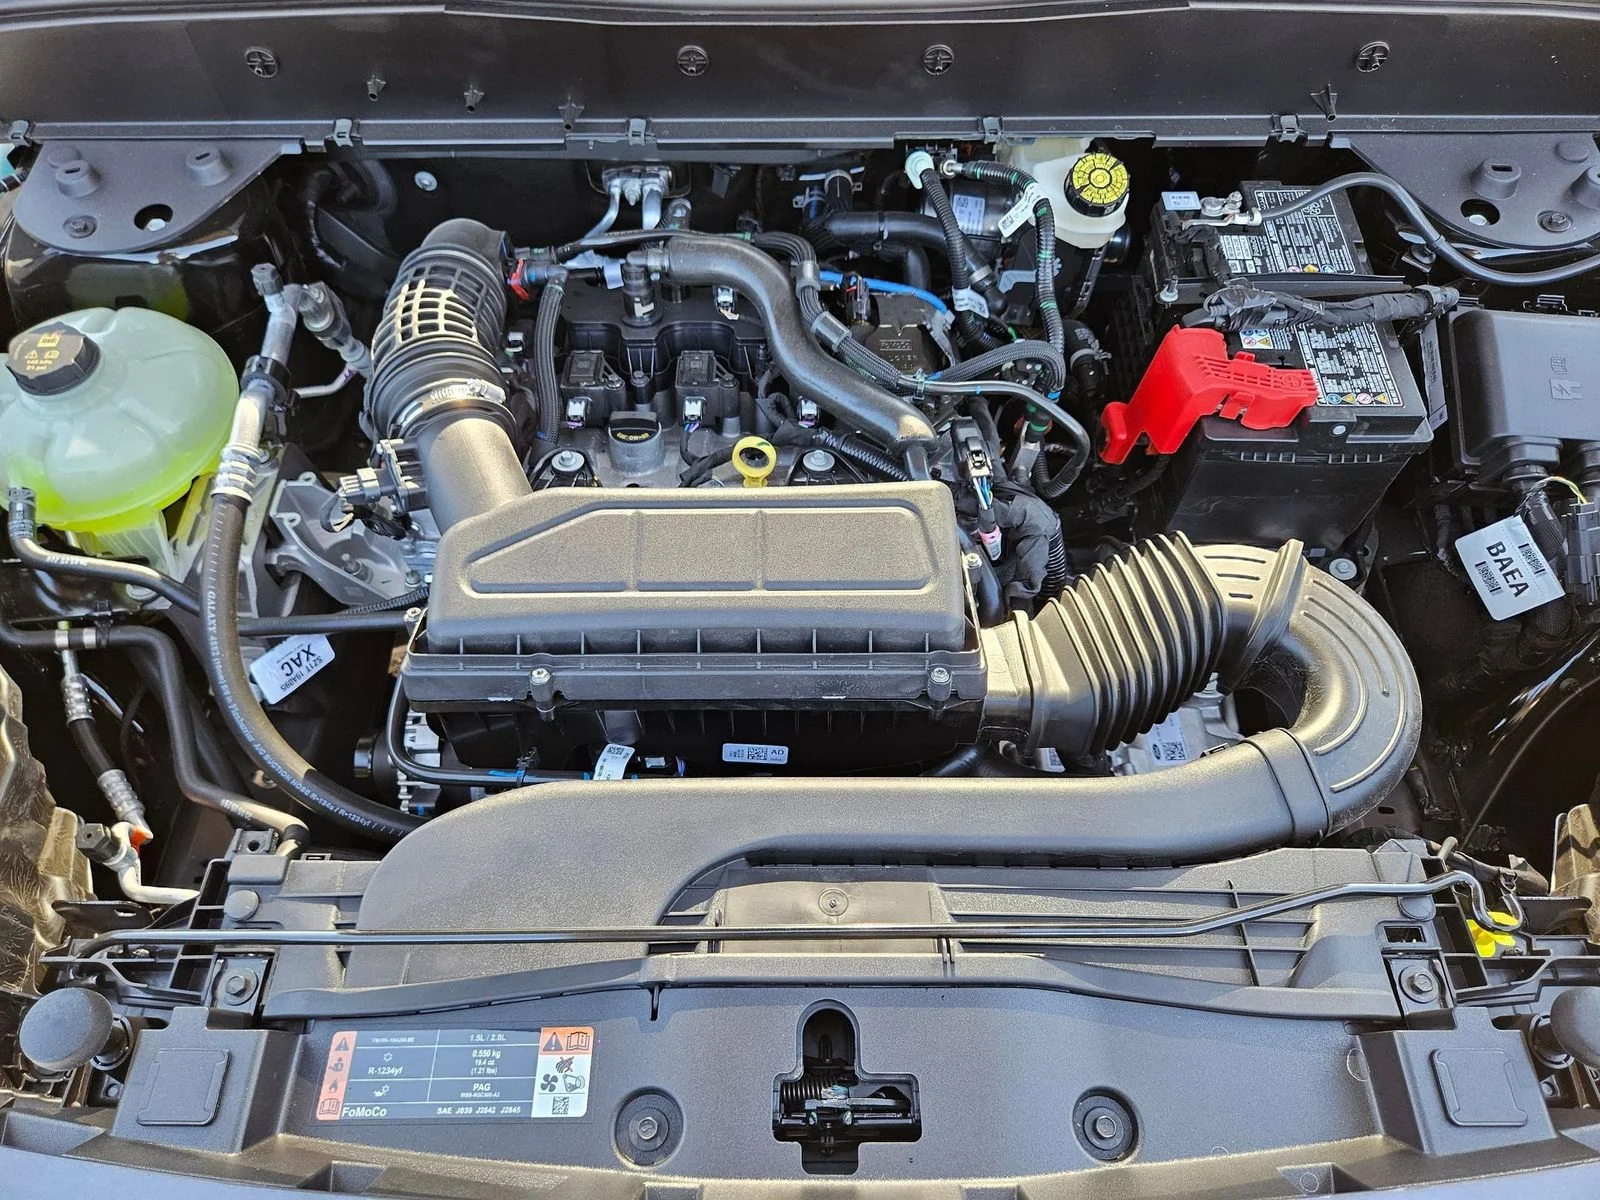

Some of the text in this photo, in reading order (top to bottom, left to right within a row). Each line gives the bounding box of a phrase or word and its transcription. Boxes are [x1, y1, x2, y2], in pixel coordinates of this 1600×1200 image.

[1486, 541, 1530, 598] BAEA
[281, 644, 318, 677] XAC
[280, 671, 304, 692] 19A095
[207, 590, 216, 633] GALAXY
[254, 742, 266, 756] A/C
[263, 753, 292, 784] SUCTION
[290, 780, 311, 798] HOSE
[338, 808, 372, 828] R-1234yf
[470, 1034, 485, 1042] 1.5L
[472, 1050, 501, 1060] 0.550 kg
[368, 1066, 403, 1076] R-1234yf
[470, 1066, 498, 1075] (1.21 lbs)
[342, 1107, 387, 1118] FoMoCo
